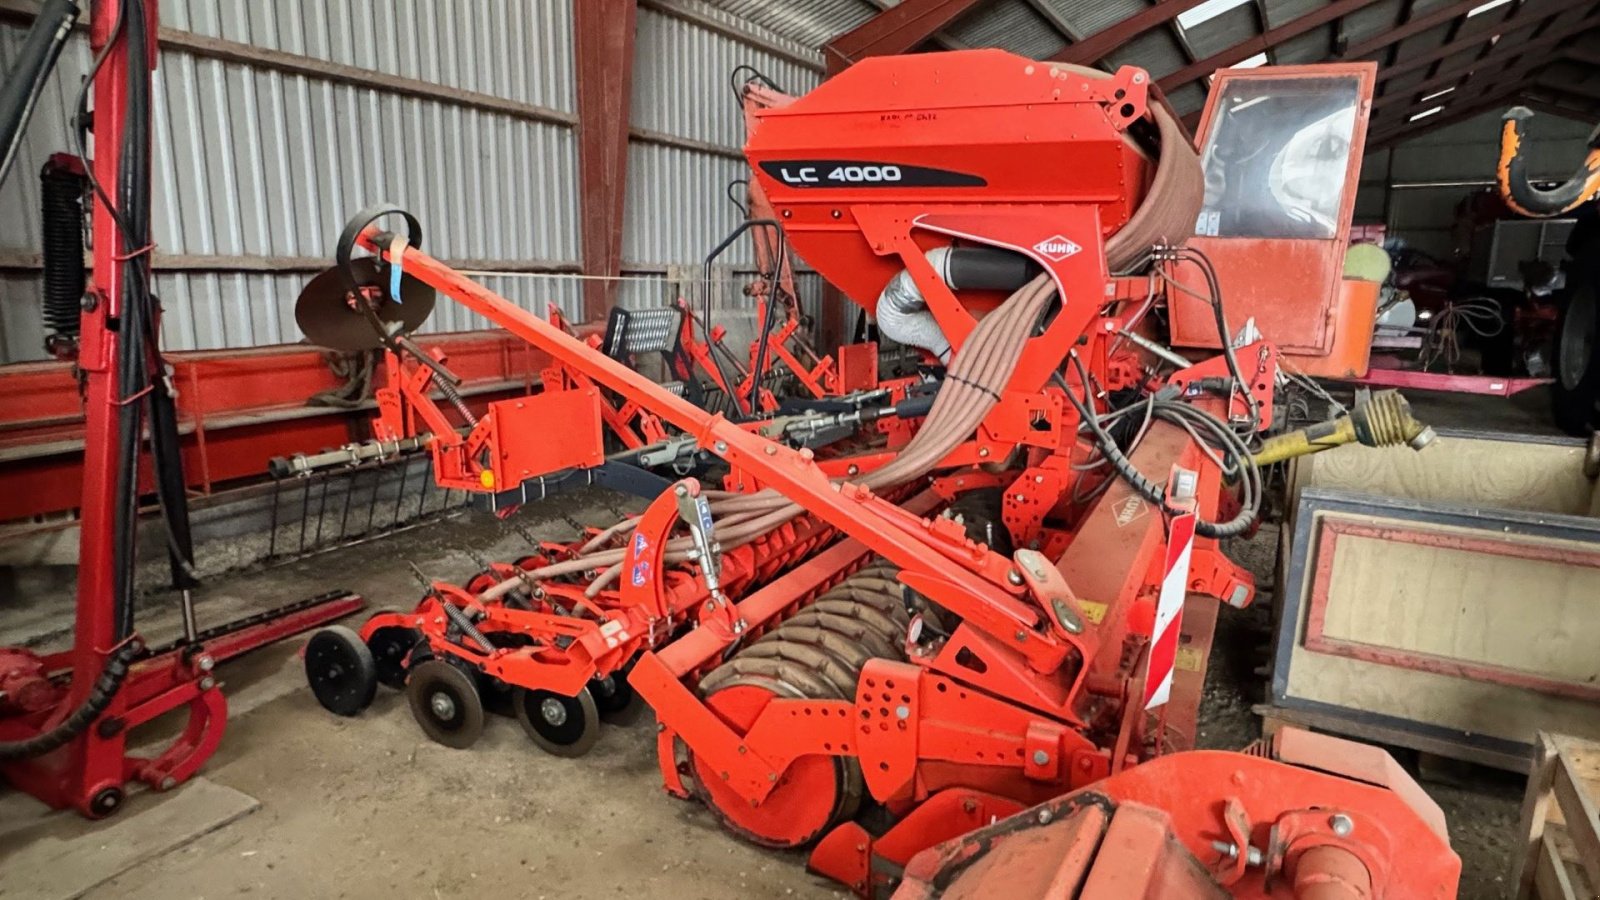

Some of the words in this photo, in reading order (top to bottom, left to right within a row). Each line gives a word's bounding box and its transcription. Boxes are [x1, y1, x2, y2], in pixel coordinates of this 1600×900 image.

[781, 167, 819, 182] LC
[828, 166, 901, 182] 4000
[1040, 242, 1075, 254] KUHN
